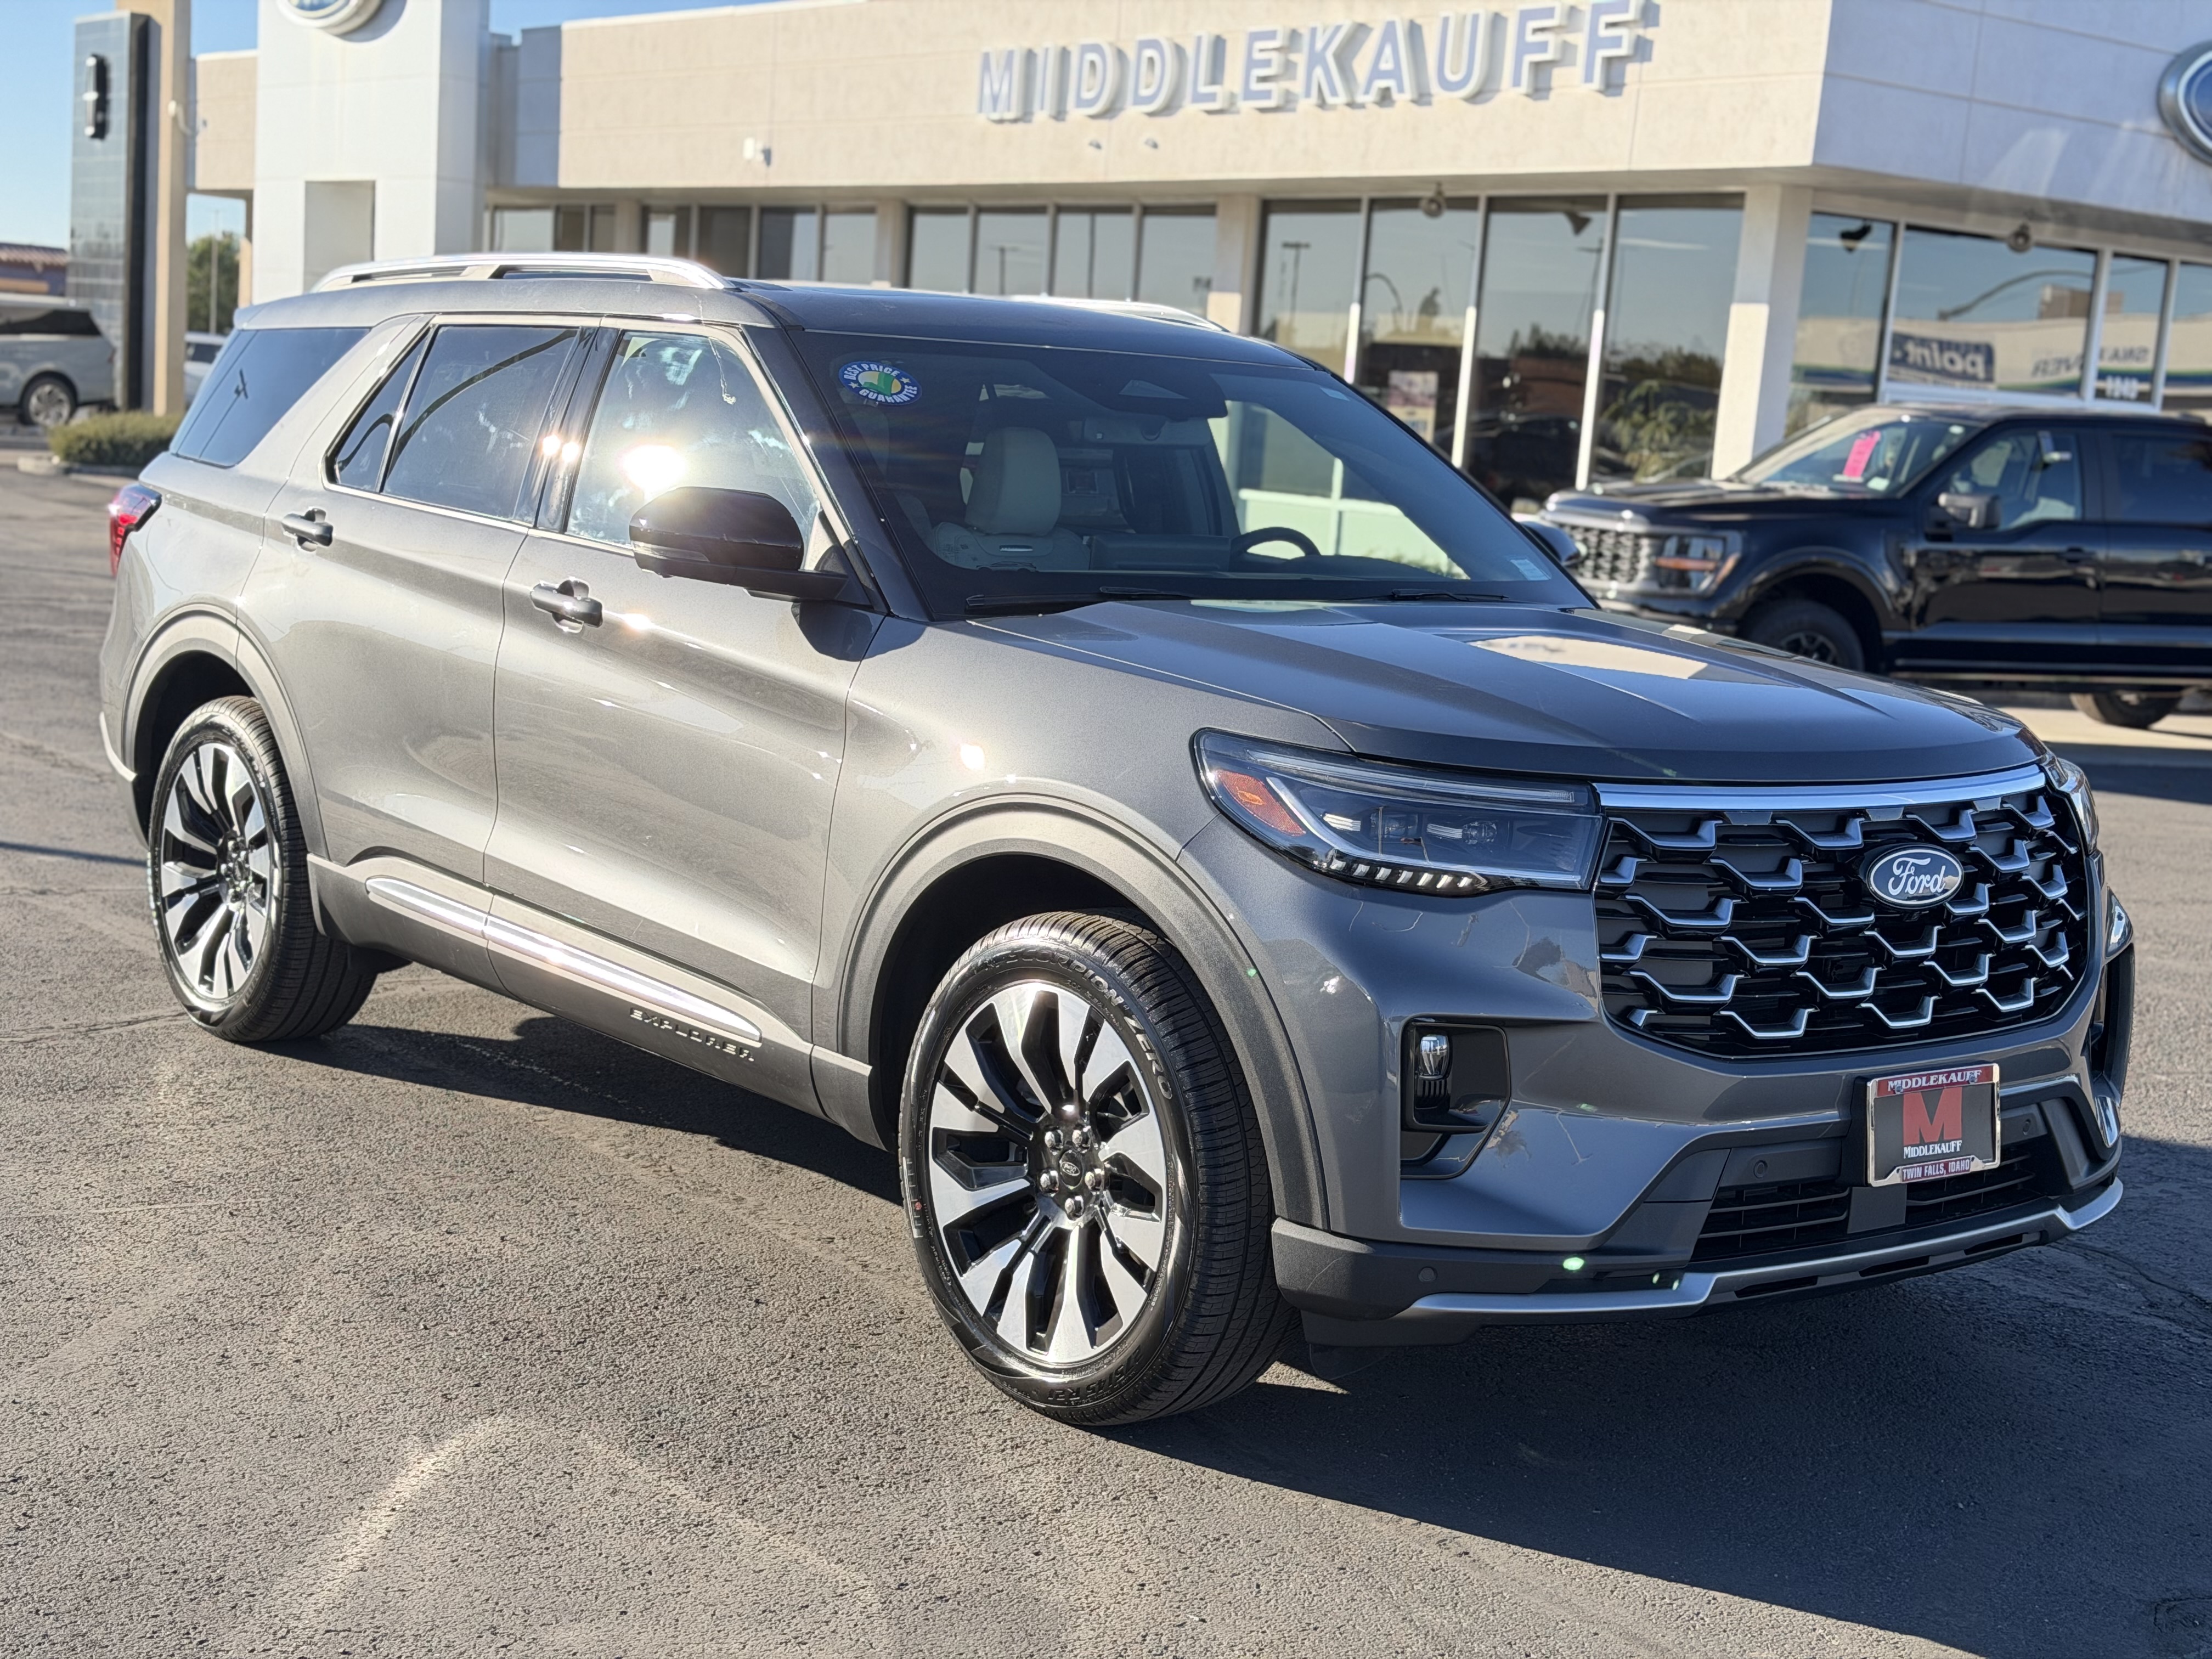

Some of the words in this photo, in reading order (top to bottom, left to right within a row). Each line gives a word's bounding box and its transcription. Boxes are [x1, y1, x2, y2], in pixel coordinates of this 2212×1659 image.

[978, 0, 1644, 119] MIDDLEKAUFF
[844, 364, 863, 381] BEST
[860, 363, 900, 377] PRICE
[859, 385, 918, 403] GUARANTEE
[1888, 857, 1946, 896] Ford
[630, 1007, 754, 1062] EXPLORER
[1888, 1069, 1982, 1092] MIDDLEKAUFF
[1903, 1086, 1963, 1146] M
[1903, 1139, 1962, 1159] MIDDLEKAUFF
[1902, 1166, 1921, 1180] TWIN
[1924, 1163, 1946, 1177] FALLS,
[1948, 1159, 1970, 1174] IDAHO
